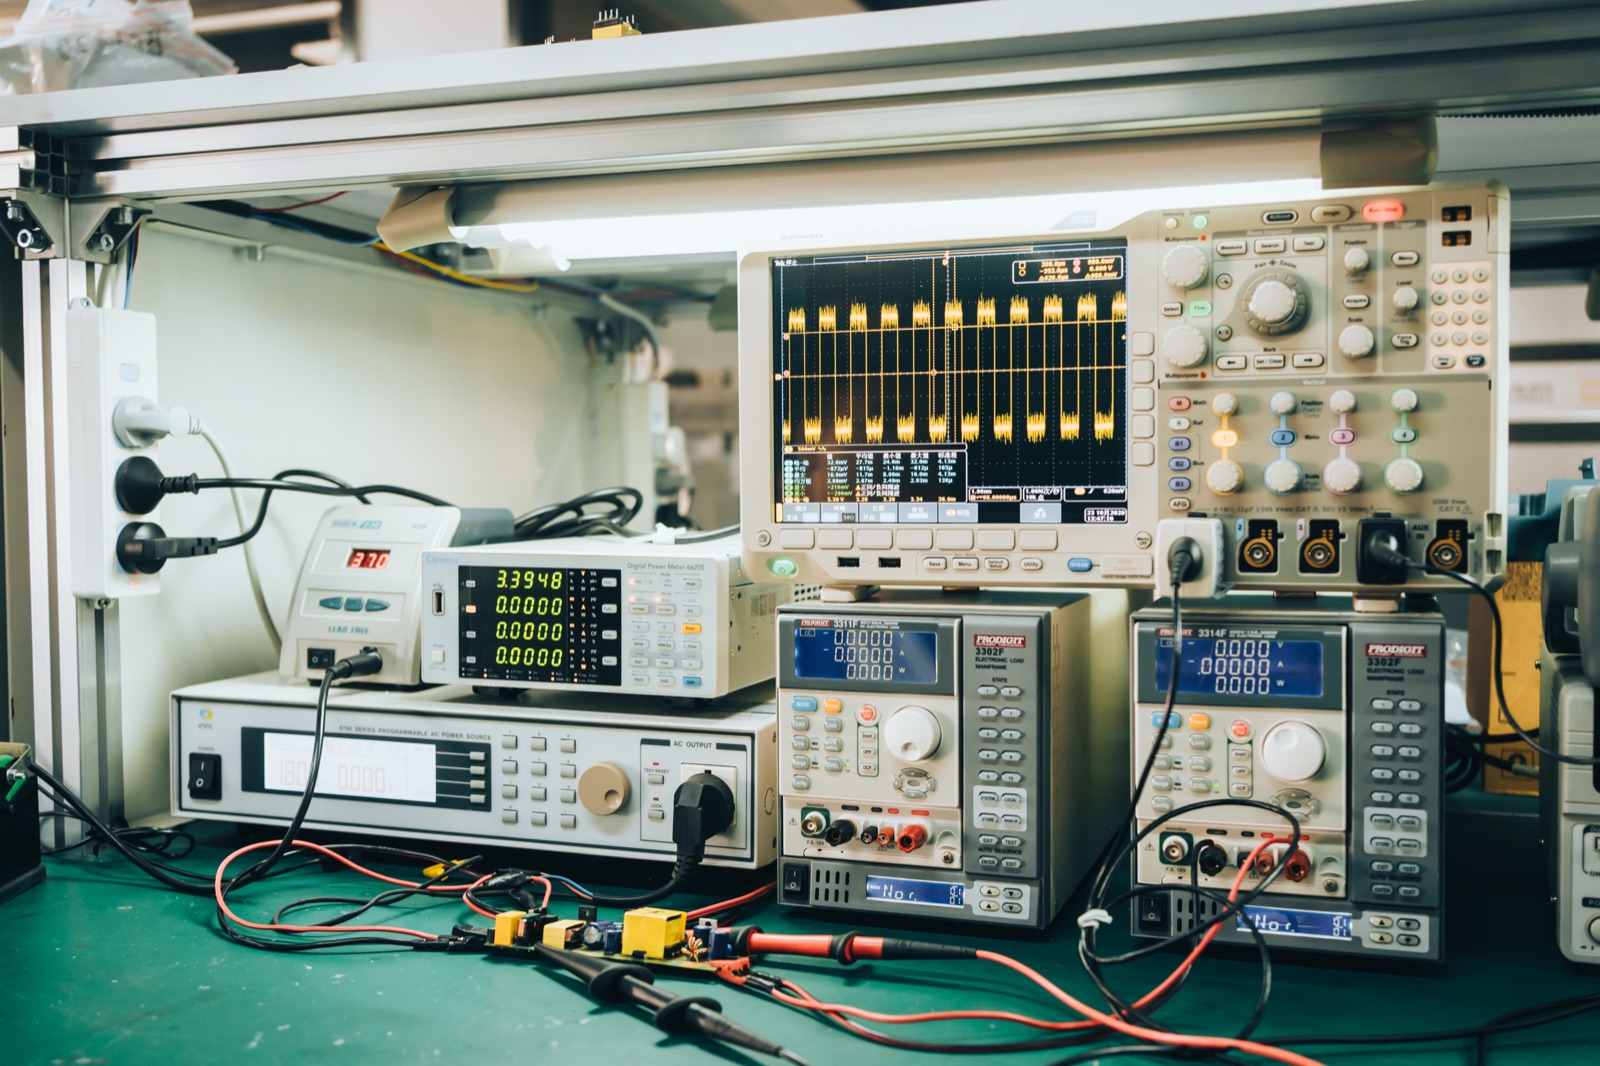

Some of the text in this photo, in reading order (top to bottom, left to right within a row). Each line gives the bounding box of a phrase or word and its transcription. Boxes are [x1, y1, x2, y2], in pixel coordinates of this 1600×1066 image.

[1279, 260, 1297, 269] Zoom
[351, 552, 389, 568] 370
[426, 554, 458, 563] Chroma
[497, 570, 562, 590] 3.3948
[496, 596, 562, 616] 0.0000
[496, 621, 562, 641] 0.0000
[1198, 629, 1227, 637] 3314F
[976, 636, 1024, 645] PRODIGIT
[496, 646, 562, 667] 0.0000
[1368, 645, 1424, 655] PRODIGIT
[1367, 658, 1401, 666] 3302F
[847, 664, 893, 680] 0.000
[1215, 676, 1270, 694] 0.000
[378, 728, 428, 737] PROGRAMMABLE
[883, 884, 916, 901] Nor.
[1255, 914, 1294, 932] Nor.
